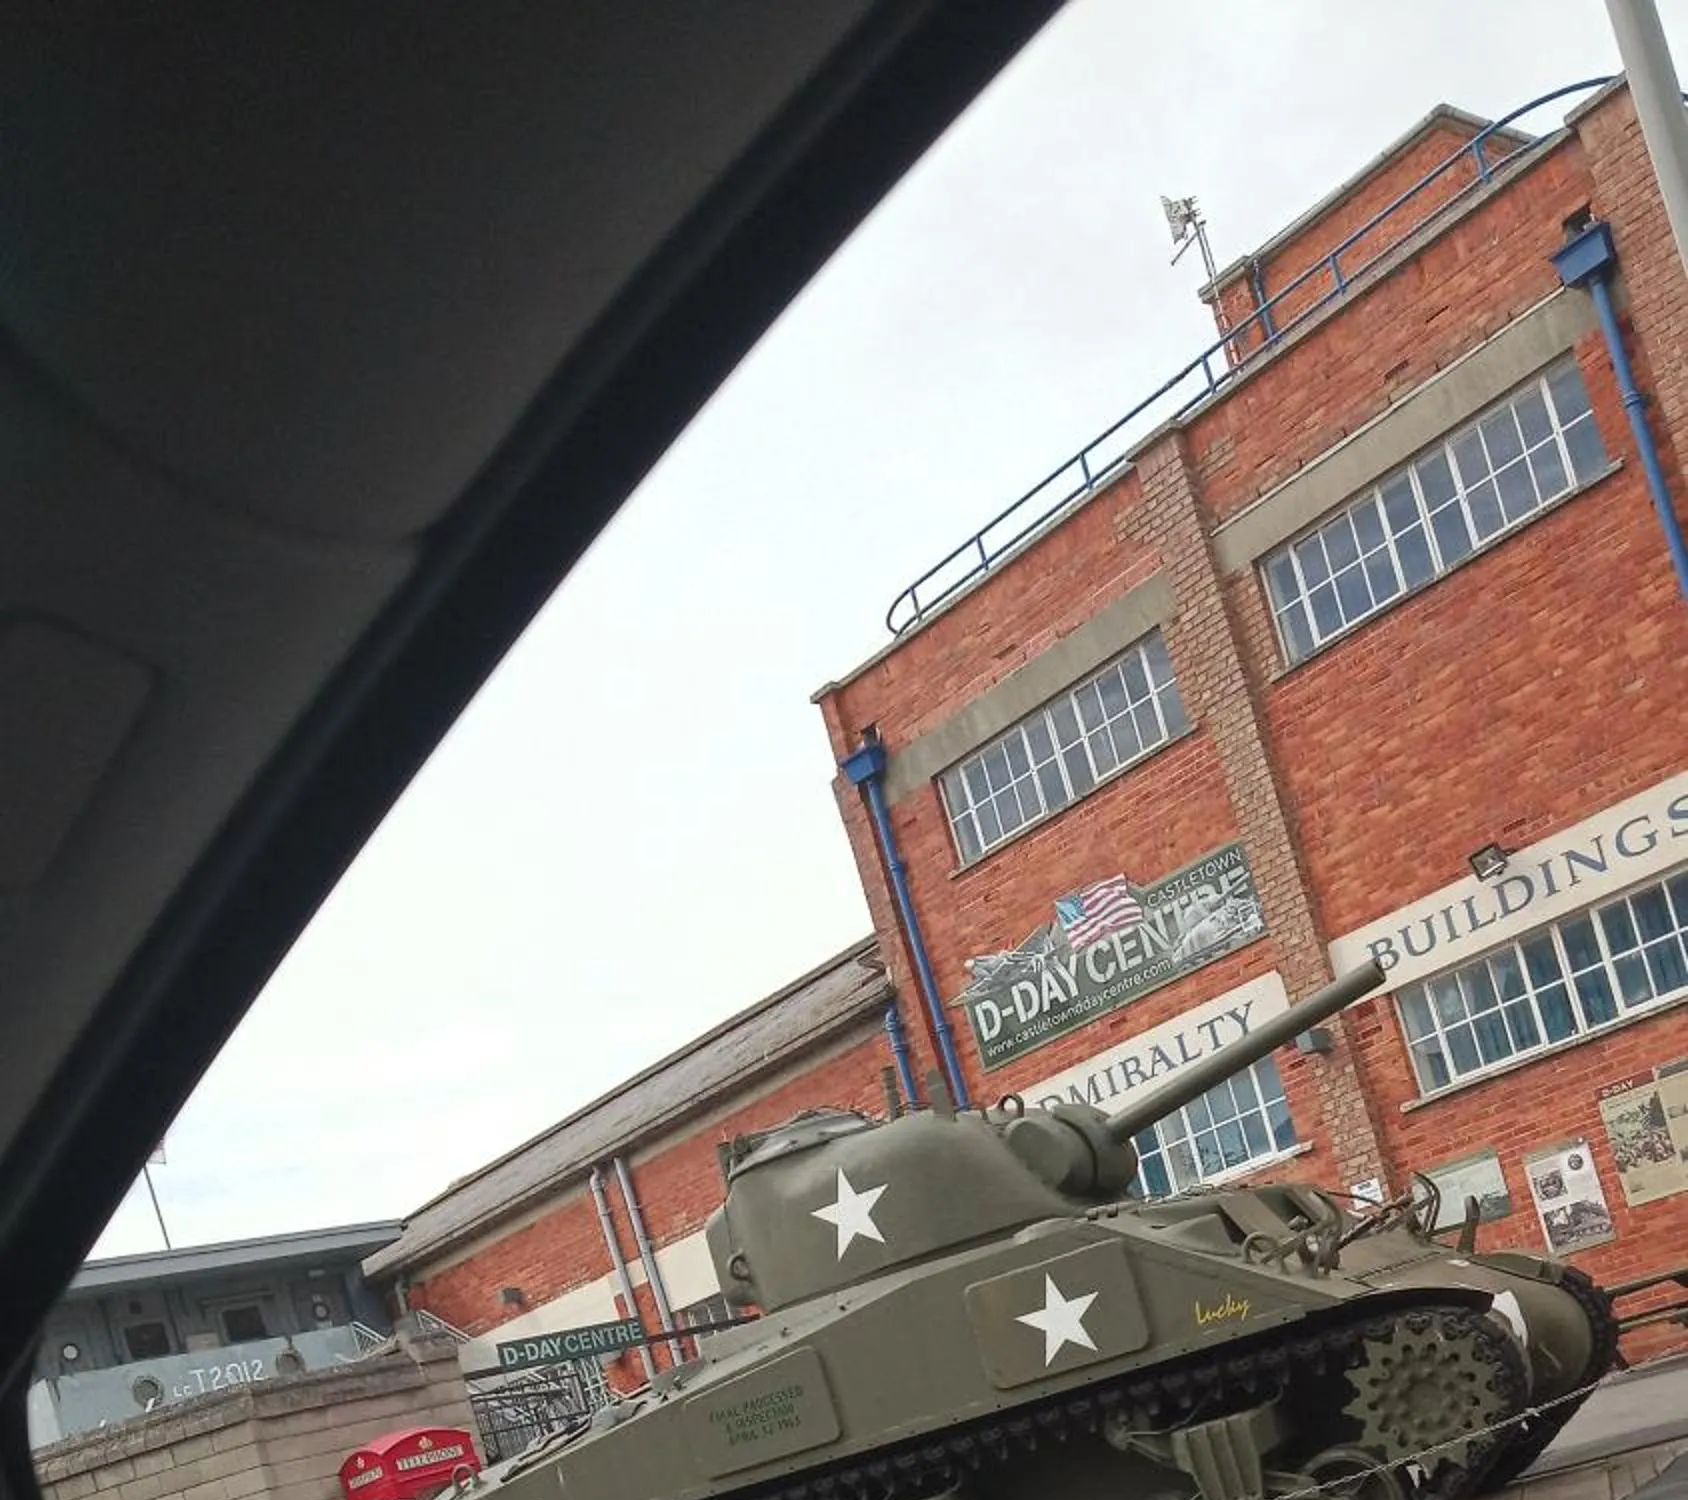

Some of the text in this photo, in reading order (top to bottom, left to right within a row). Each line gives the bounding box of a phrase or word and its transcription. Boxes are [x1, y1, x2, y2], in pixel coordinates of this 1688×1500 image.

[1147, 848, 1242, 908] CASTLETOWN
[974, 951, 1080, 1042] D-DAY
[986, 956, 1172, 1058] www.castletownddaycentre.com
[1195, 1293, 1249, 1325] Lucky
[503, 1322, 643, 1366] D-DAY CENTRE
